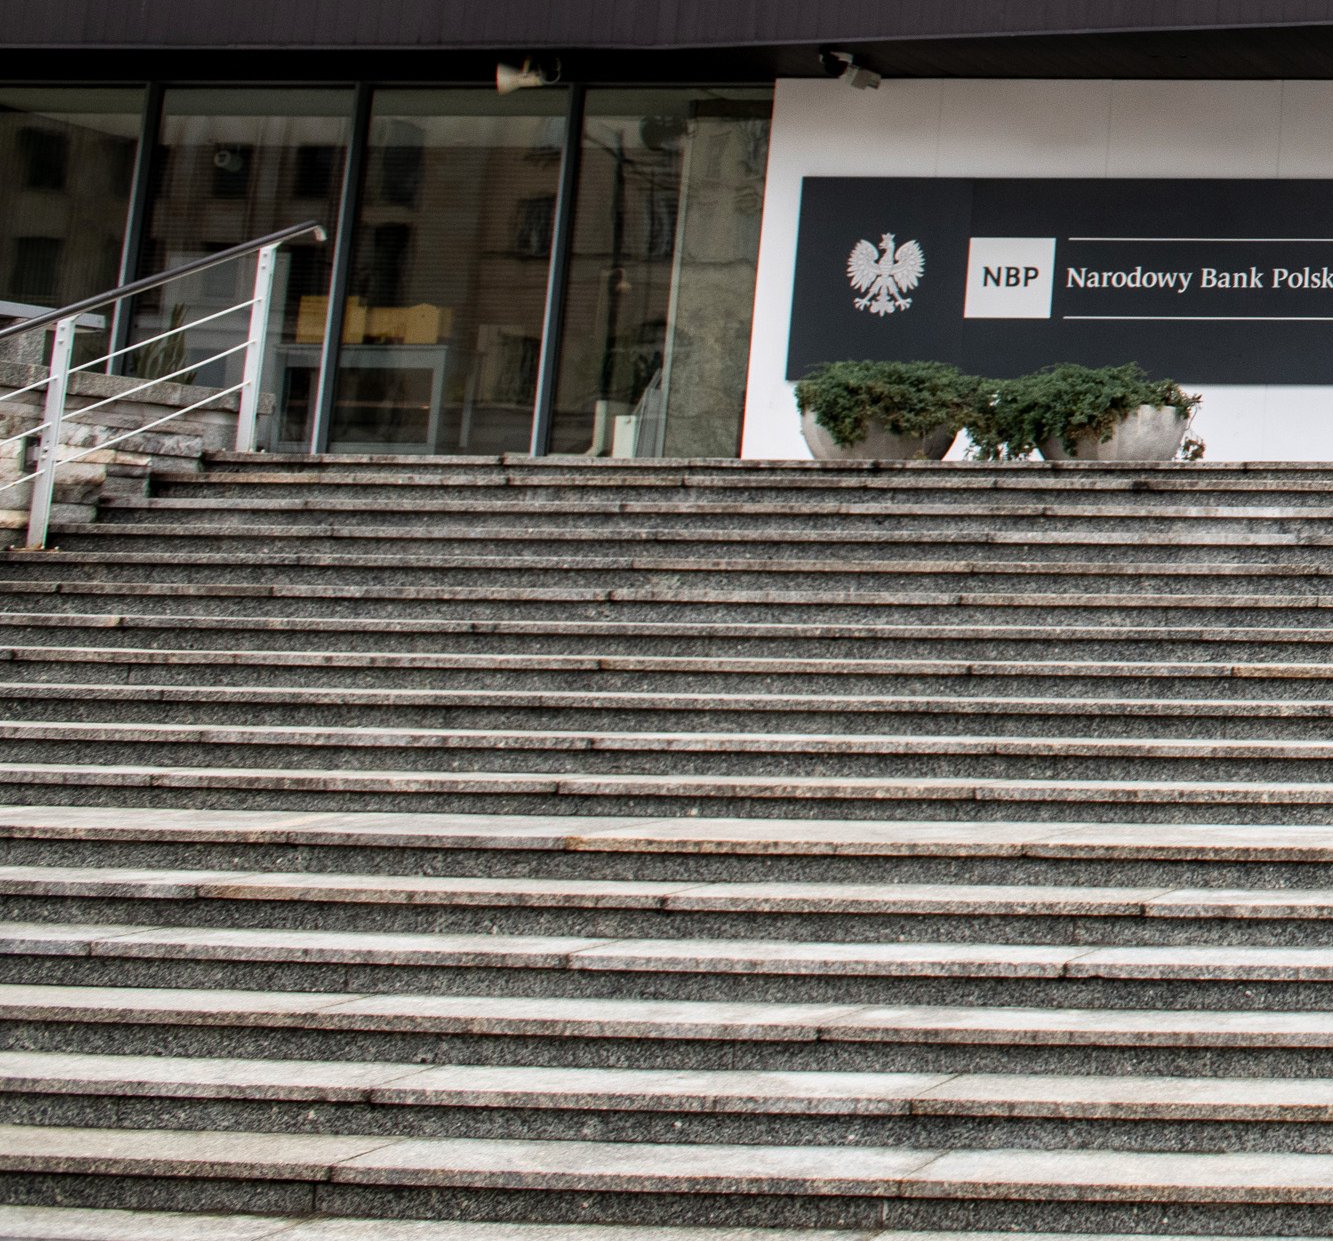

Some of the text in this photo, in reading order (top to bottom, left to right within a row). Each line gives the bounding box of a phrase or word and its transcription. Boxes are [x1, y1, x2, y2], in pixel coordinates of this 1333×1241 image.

[983, 266, 1039, 287] NBP
[1066, 266, 1193, 294] Narodowy
[1200, 266, 1264, 289] Bank
